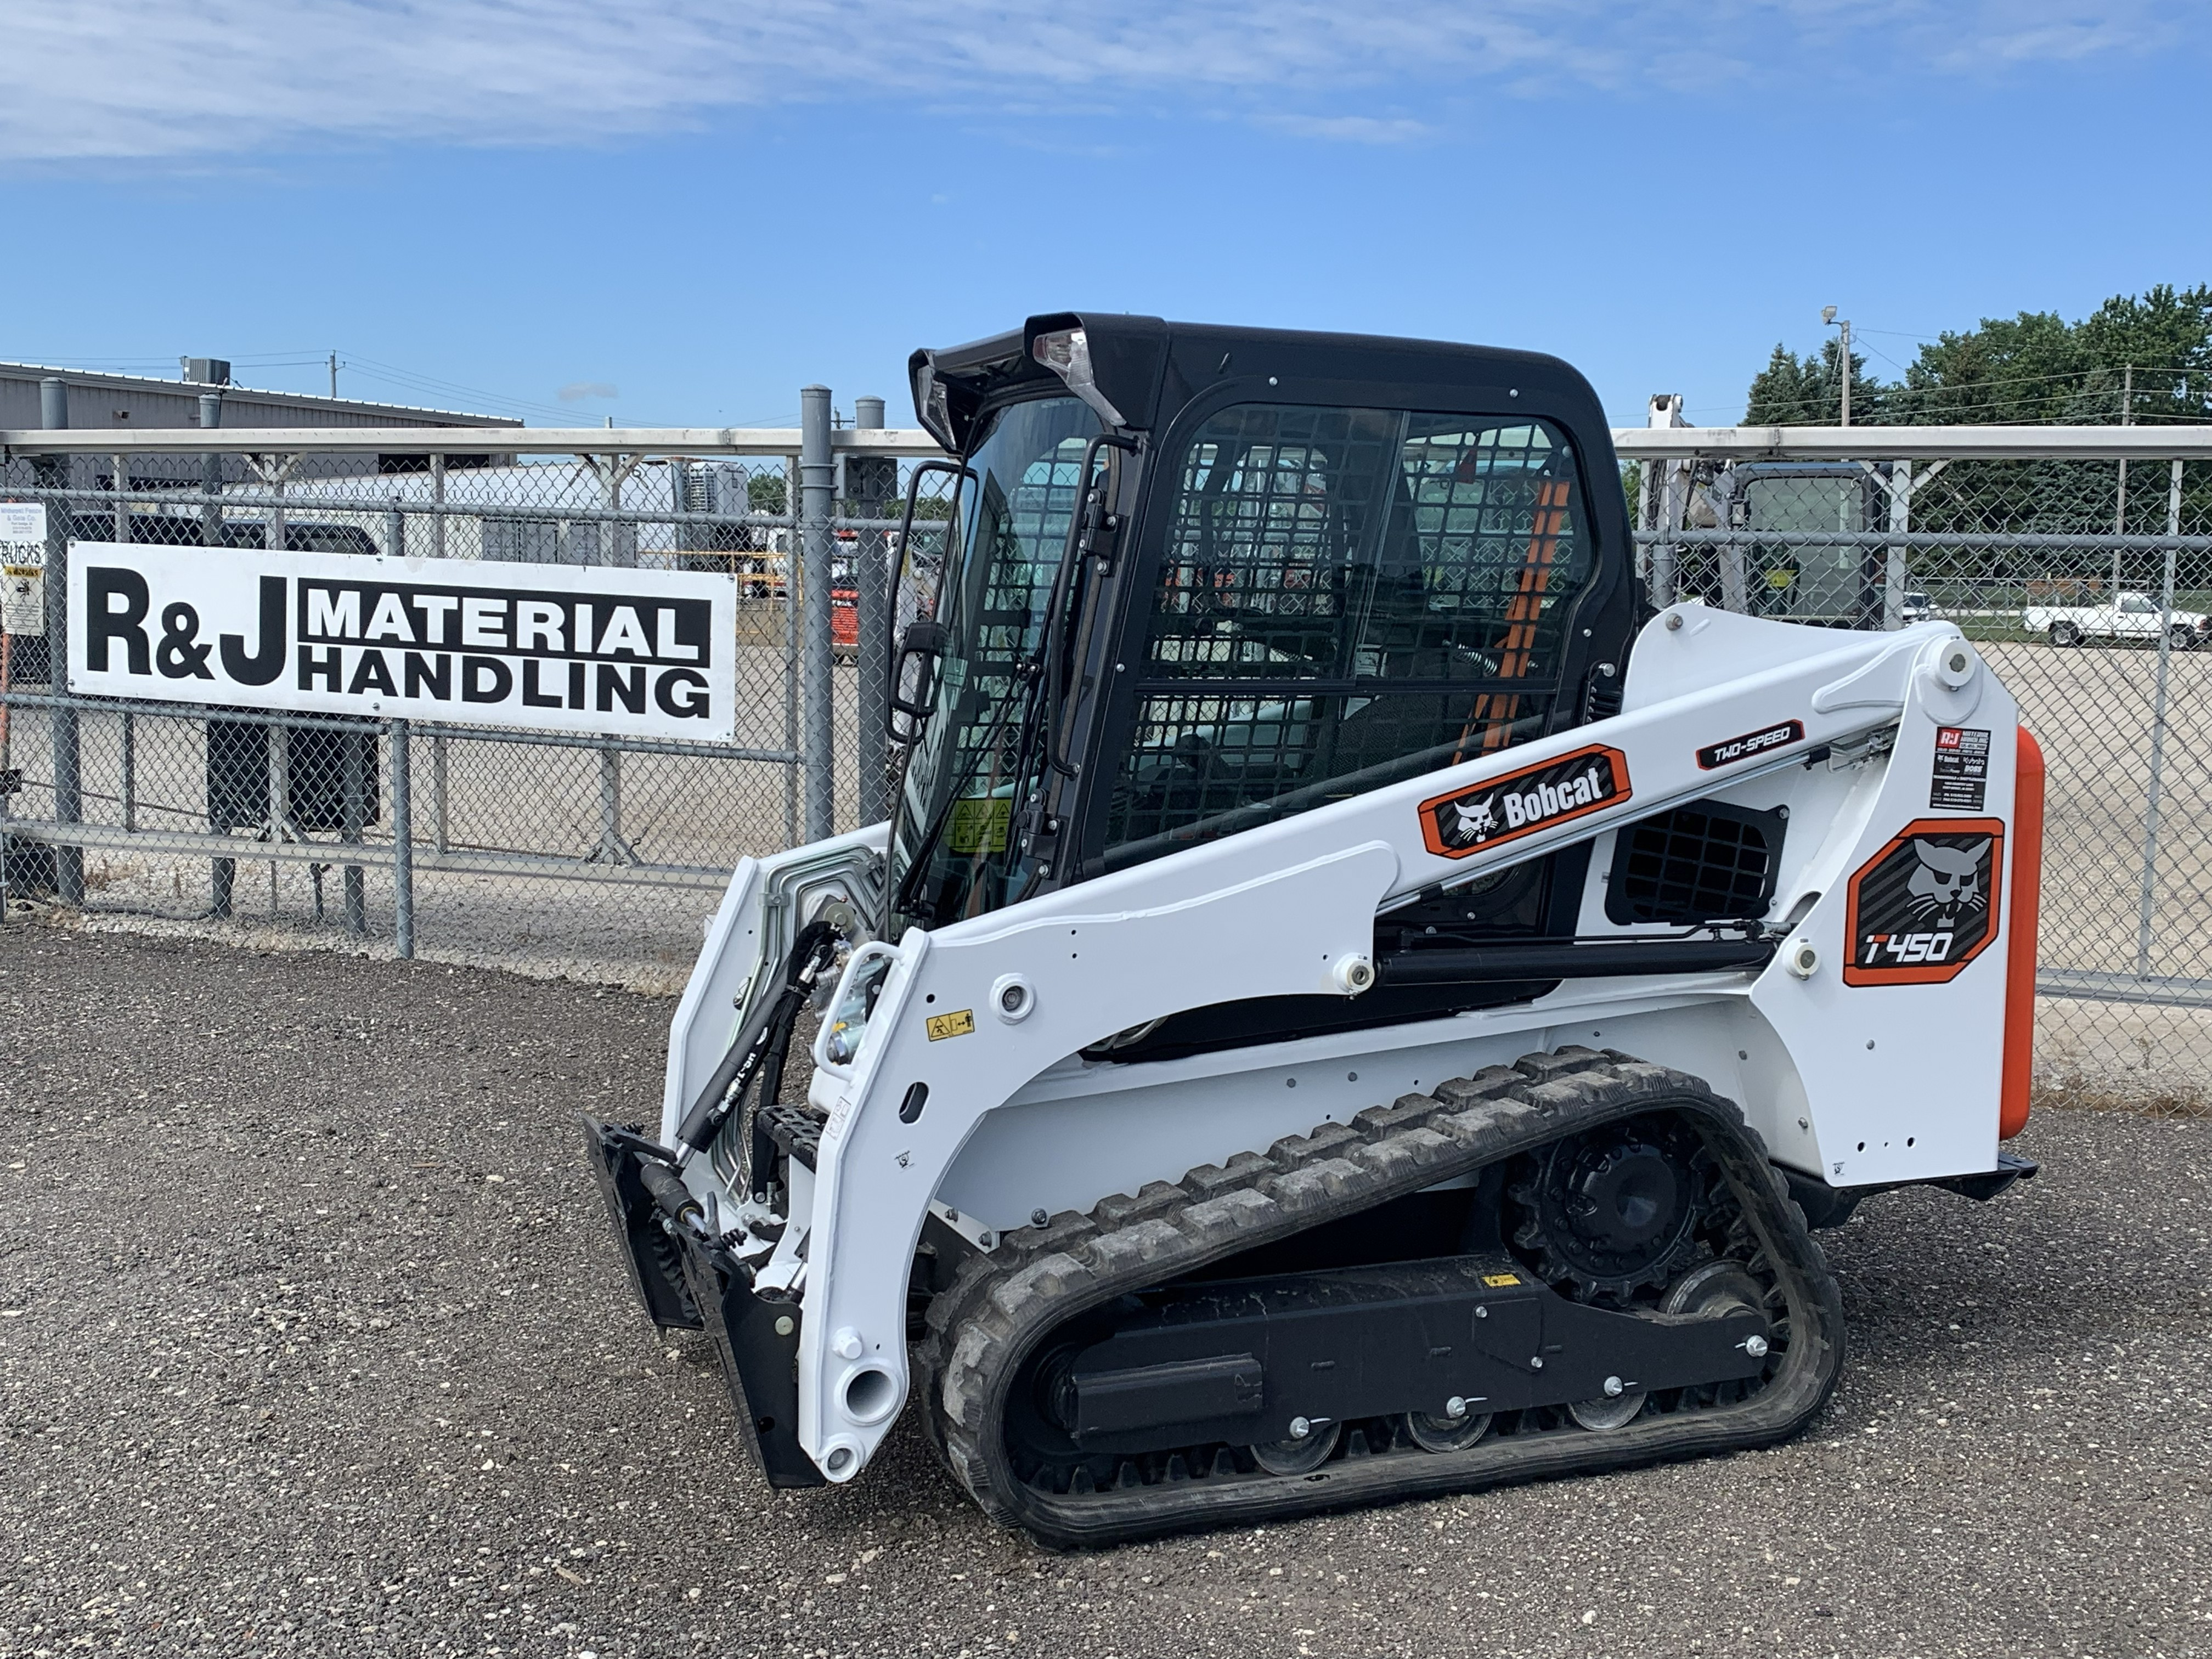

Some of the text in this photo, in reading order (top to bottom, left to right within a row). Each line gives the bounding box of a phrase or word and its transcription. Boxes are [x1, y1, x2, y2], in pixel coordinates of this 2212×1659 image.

[0, 544, 41, 564] RUCKS
[87, 567, 287, 686] R&J
[308, 589, 699, 660] MATERIAL
[297, 645, 711, 719] HANDLING
[1714, 726, 1791, 762] TWO-SPEED
[1963, 757, 1985, 765] Kubota
[1503, 767, 1603, 829] Bobcat
[1865, 932, 1954, 964] T450
